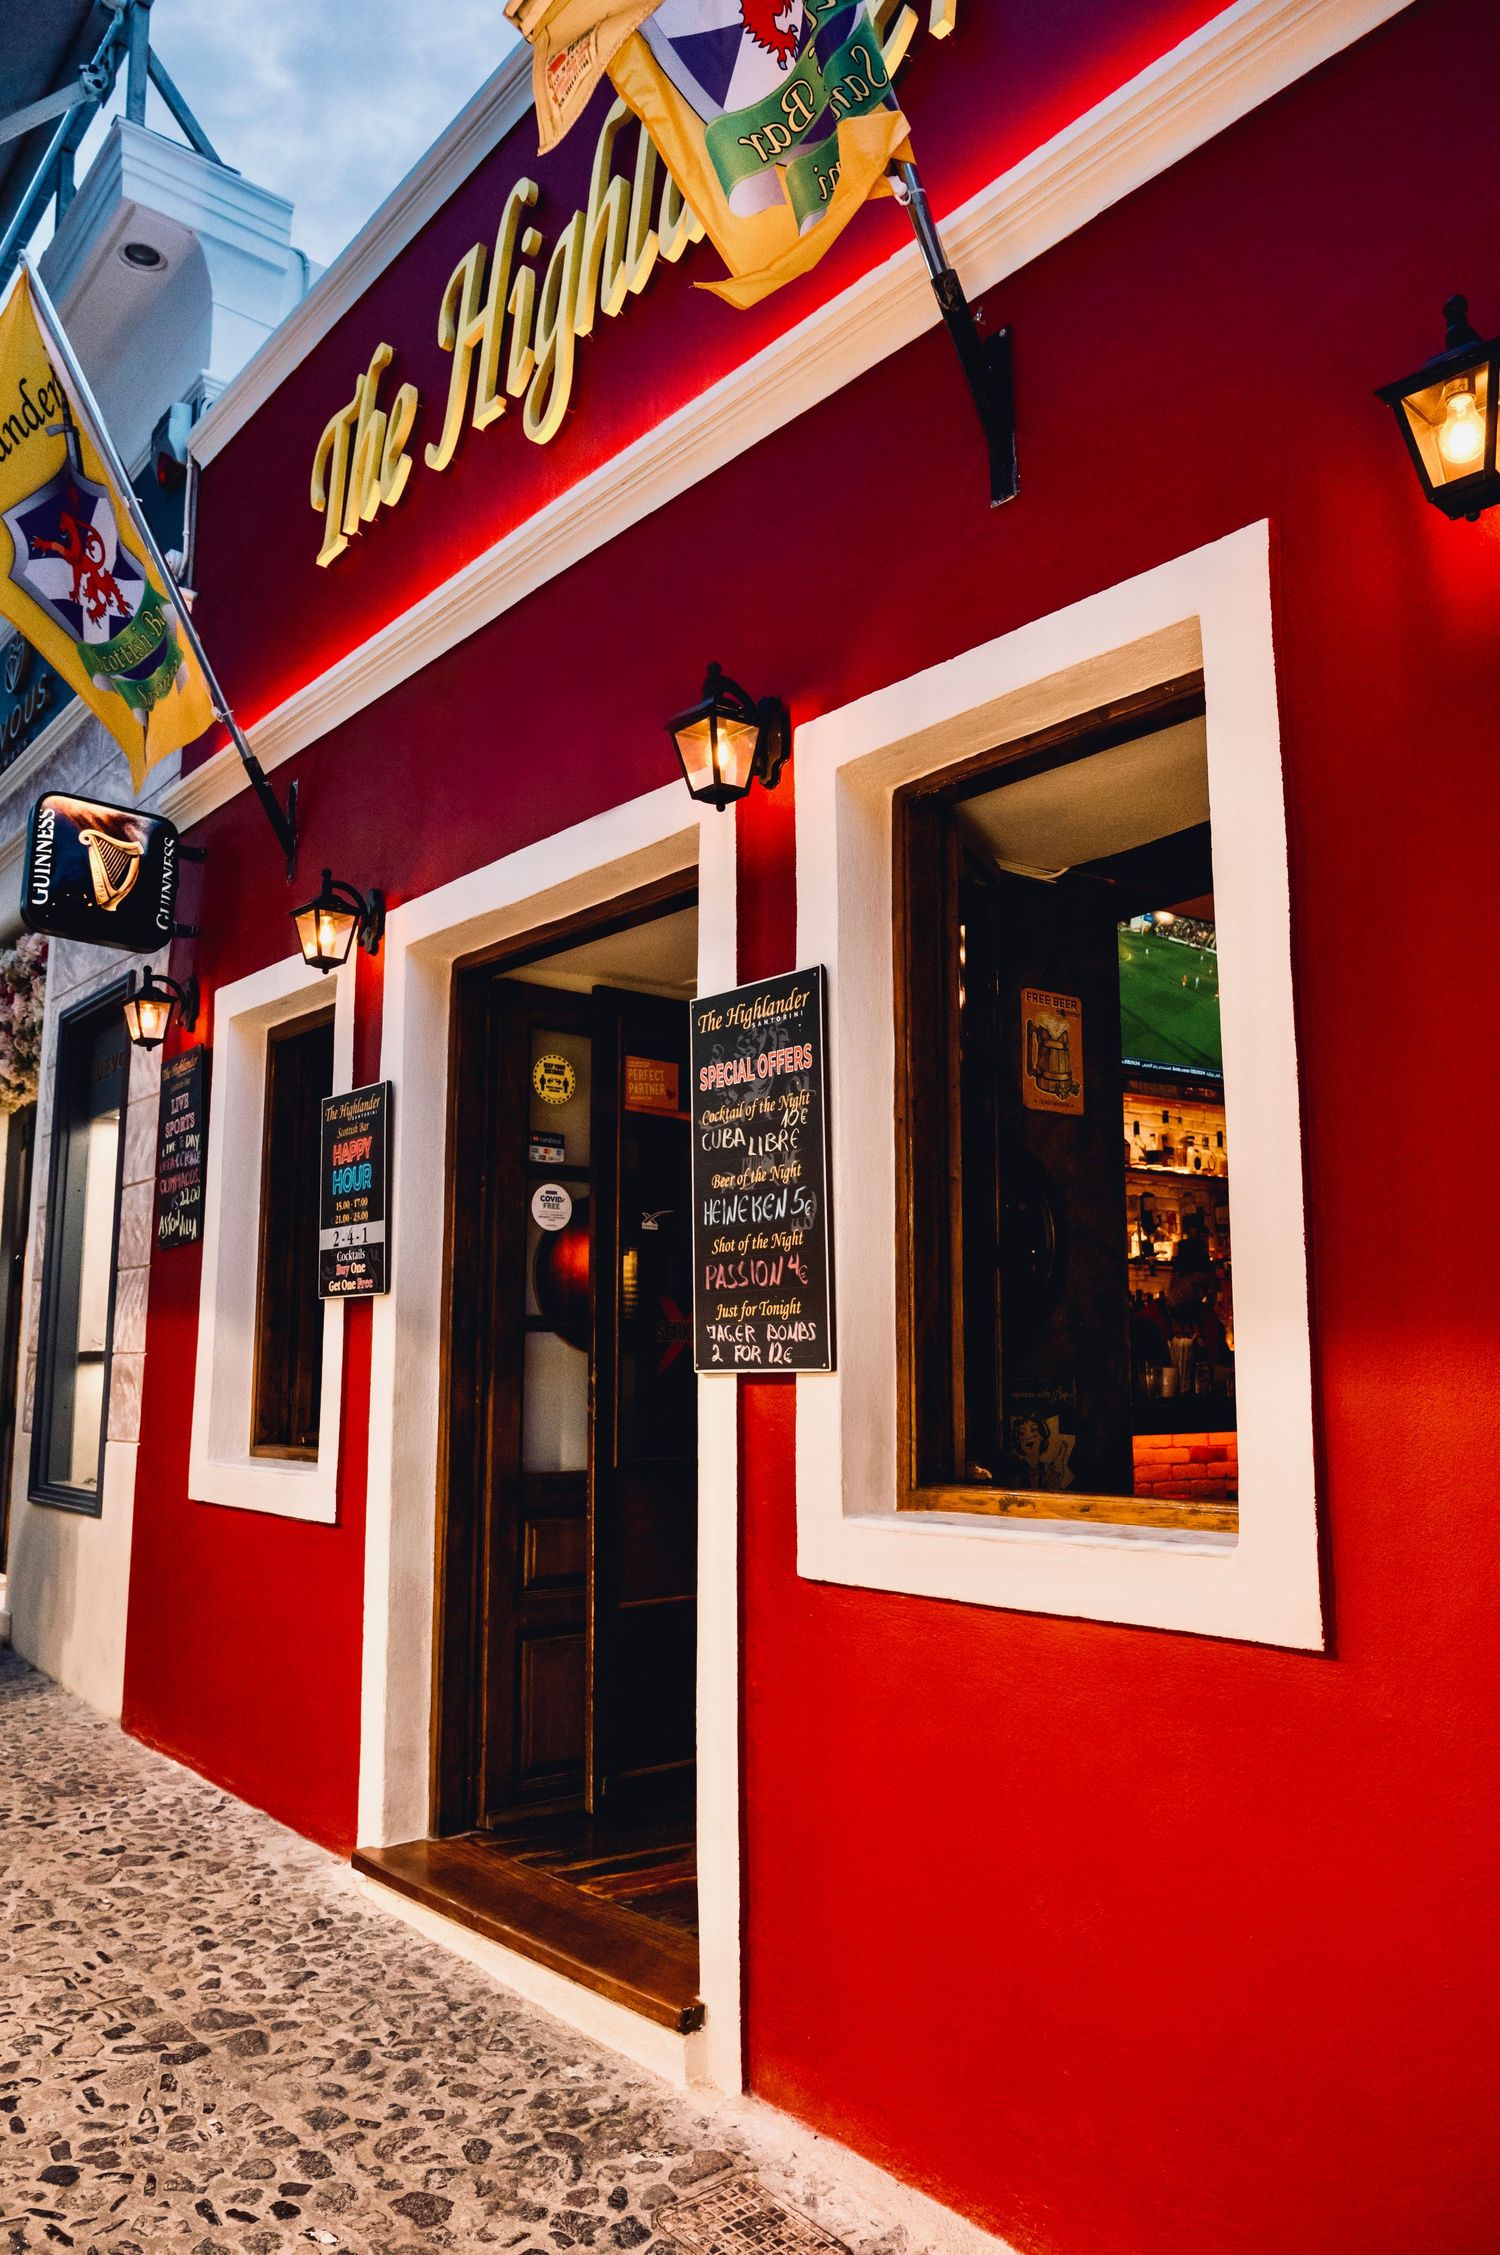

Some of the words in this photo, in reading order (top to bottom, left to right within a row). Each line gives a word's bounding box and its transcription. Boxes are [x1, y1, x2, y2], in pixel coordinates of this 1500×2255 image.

[310, 342, 419, 568] The
[31, 807, 56, 906] GUINNESS
[155, 836, 175, 931] GUINNESS
[698, 1009, 722, 1034] The
[725, 987, 810, 1030] Highlander
[1026, 992, 1050, 1005] FREE
[1053, 997, 1077, 1009] BEER
[751, 1010, 804, 1028] SANTORINI
[627, 1068, 665, 1081] PERFECT
[699, 1056, 756, 1091] SPECIAL
[756, 1042, 813, 1079] OFFERS
[628, 1082, 666, 1096] PARTNER
[170, 1091, 190, 1115] LIVE
[326, 1104, 338, 1122] The
[339, 1093, 380, 1121] Highlander
[702, 1101, 745, 1126] Cocktail
[745, 1097, 757, 1120] of
[759, 1096, 775, 1114] the
[778, 1089, 810, 1113] Night
[165, 1112, 196, 1139] SPORTS
[332, 1136, 373, 1166] HAPPY
[701, 1127, 746, 1152] CUBA
[747, 1128, 800, 1157] LIBRE
[332, 1163, 372, 1196] HOUR
[712, 1174, 735, 1189] Beer
[736, 1171, 749, 1190] of
[751, 1168, 767, 1184] the
[769, 1163, 802, 1183] Night
[703, 1187, 788, 1225] HEINEKEN
[336, 1248, 366, 1262] Cocktails
[712, 1237, 735, 1255] Shot
[738, 1233, 750, 1255] of
[752, 1232, 767, 1249] the
[771, 1228, 803, 1252] Night
[336, 1264, 350, 1277] Buy
[350, 1261, 366, 1274] One
[705, 1256, 783, 1290] PASSION
[329, 1280, 341, 1292] Get
[341, 1279, 356, 1291] One
[357, 1277, 373, 1289] Free
[717, 1303, 738, 1320] Just
[738, 1299, 758, 1322] for
[759, 1297, 801, 1320] Tonight
[766, 1321, 816, 1342] BOMBS
[711, 1345, 723, 1362] 2
[734, 1344, 762, 1364] FOR
